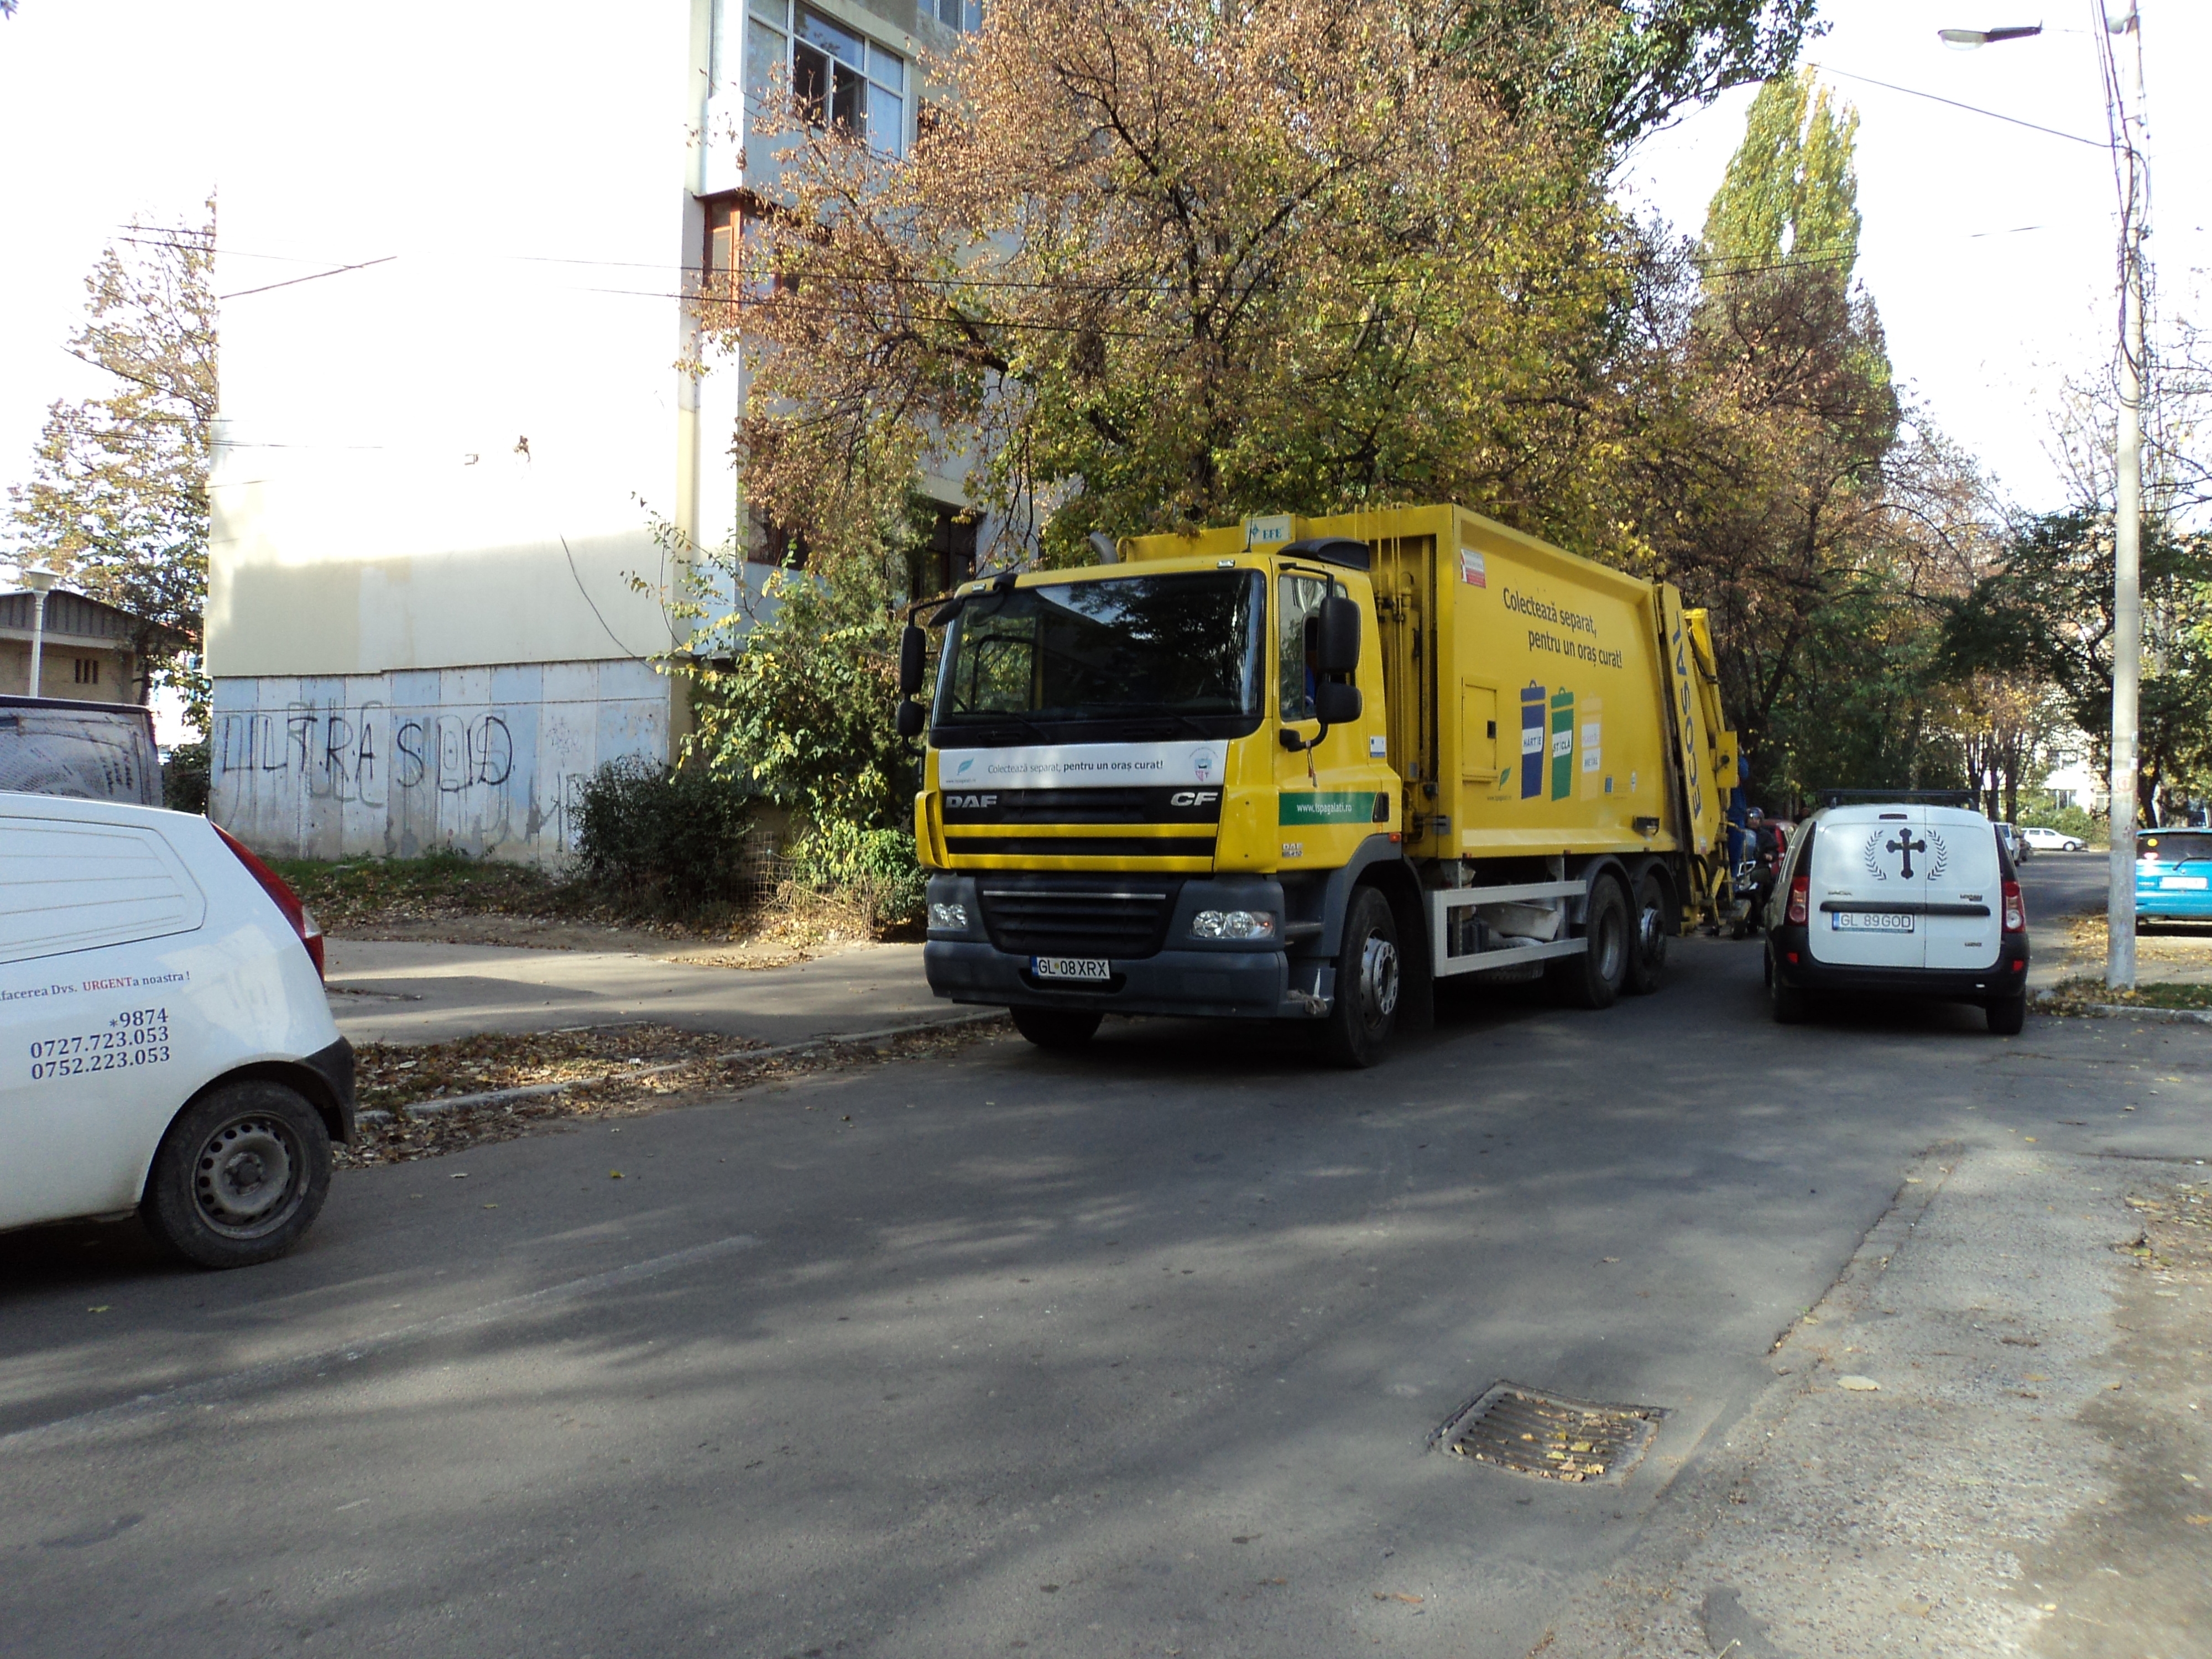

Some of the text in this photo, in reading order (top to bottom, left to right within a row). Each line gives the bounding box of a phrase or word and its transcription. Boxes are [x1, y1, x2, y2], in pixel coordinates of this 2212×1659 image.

[1503, 587, 1597, 638] Colectează separat,
[1528, 630, 1623, 669] pentru un oraș curat!
[1672, 611, 1703, 820] ECOSAL
[988, 764, 1028, 774] Colectează
[1030, 763, 1061, 773] separat,
[1063, 761, 1094, 773] pentru
[1111, 761, 1132, 771] oraș
[1134, 760, 1164, 769] curat!
[945, 795, 998, 808] DAF
[1171, 792, 1219, 806] CF
[1297, 802, 1353, 815] www.ispagalati.ro
[1840, 915, 1858, 926] GL
[1039, 959, 1056, 974] GL
[0, 989, 48, 1001] facerea
[51, 984, 77, 995] Dvs.
[142, 974, 184, 985] noastra
[30, 1026, 169, 1058] 0727.723.053
[31, 1046, 170, 1079] 0752.223.053
